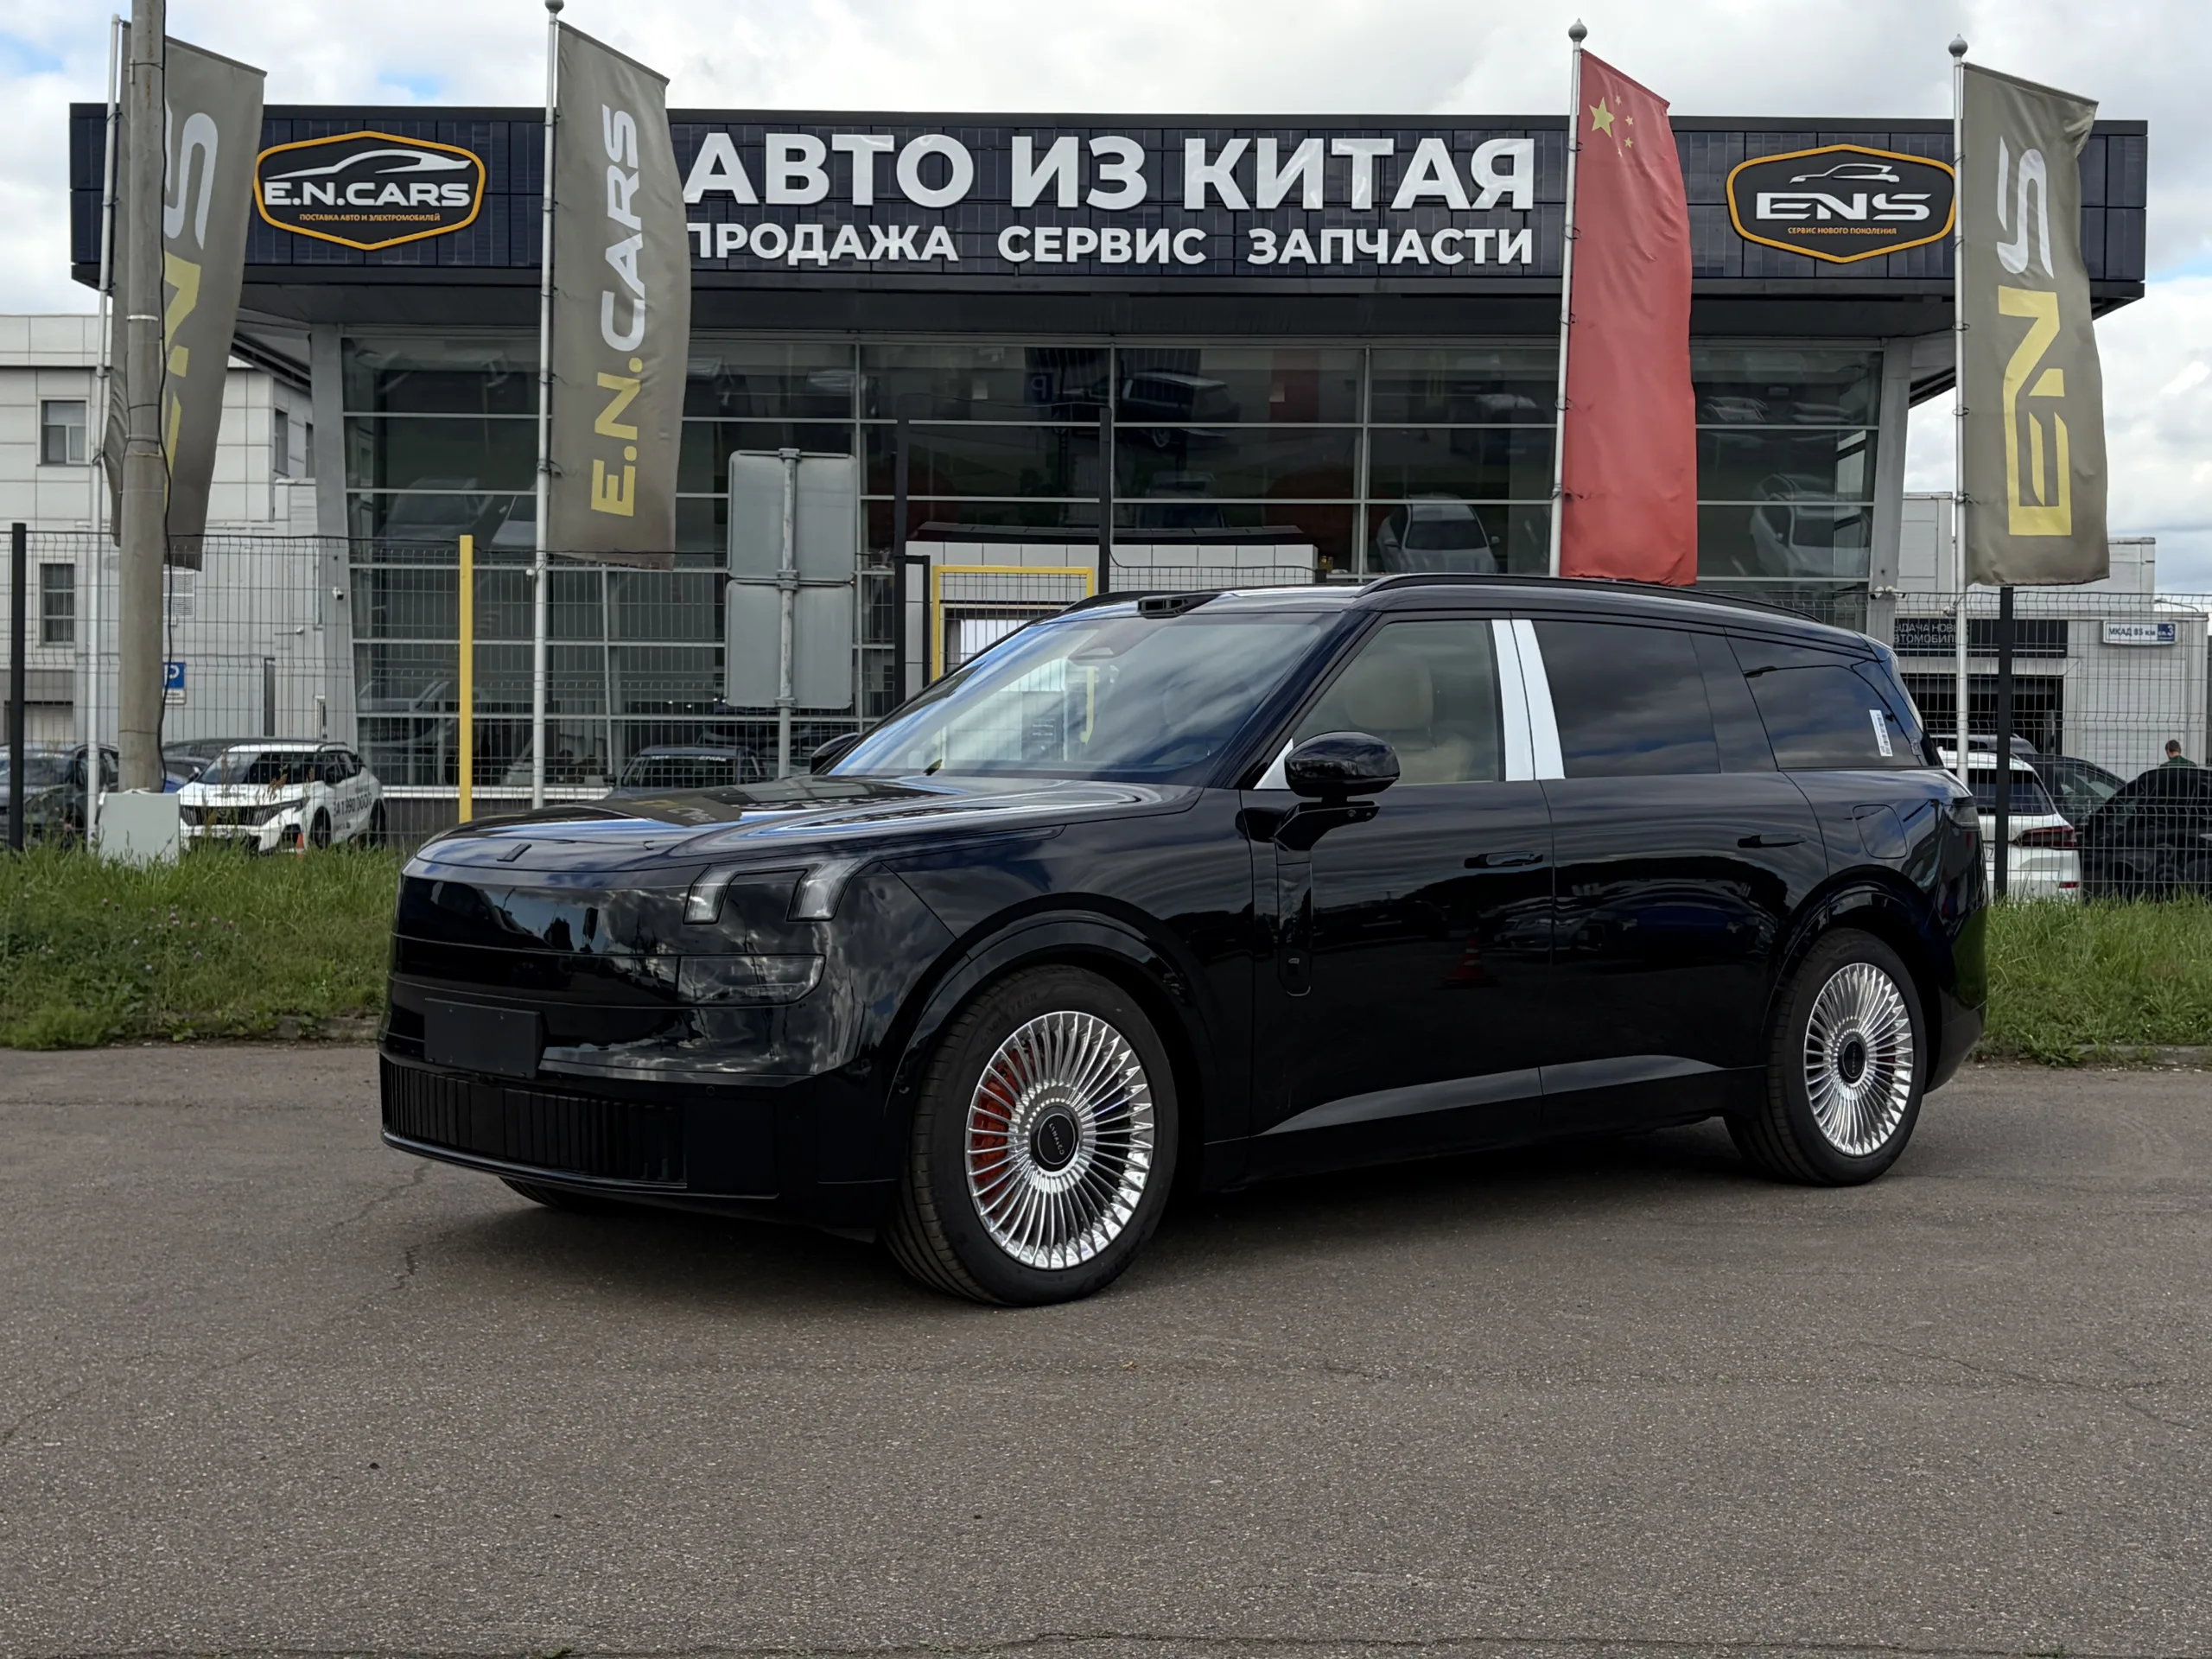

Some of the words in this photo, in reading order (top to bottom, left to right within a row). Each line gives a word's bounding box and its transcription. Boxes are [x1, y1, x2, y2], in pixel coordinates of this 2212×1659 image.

[682, 132, 974, 208] АВТО
[1011, 136, 1147, 210] ИЗ
[1184, 138, 1535, 210] КИТАЯ
[264, 181, 471, 207] E.N.CARS
[1756, 192, 1932, 221] ENS
[299, 213, 339, 222] ПОСТАВКА
[340, 213, 360, 222] АВТО
[369, 213, 441, 222] ЭЛЕКТРОМОБИЛЕЙ
[1788, 226, 1816, 235] СЕРВИС
[1817, 226, 1849, 235] НОВОГО
[997, 226, 1207, 265] СЕРВИС
[1247, 228, 1533, 265] ЗАПЧАСТИ
[591, 104, 646, 517] E.N.CARS
[1996, 135, 2072, 536] ENS
